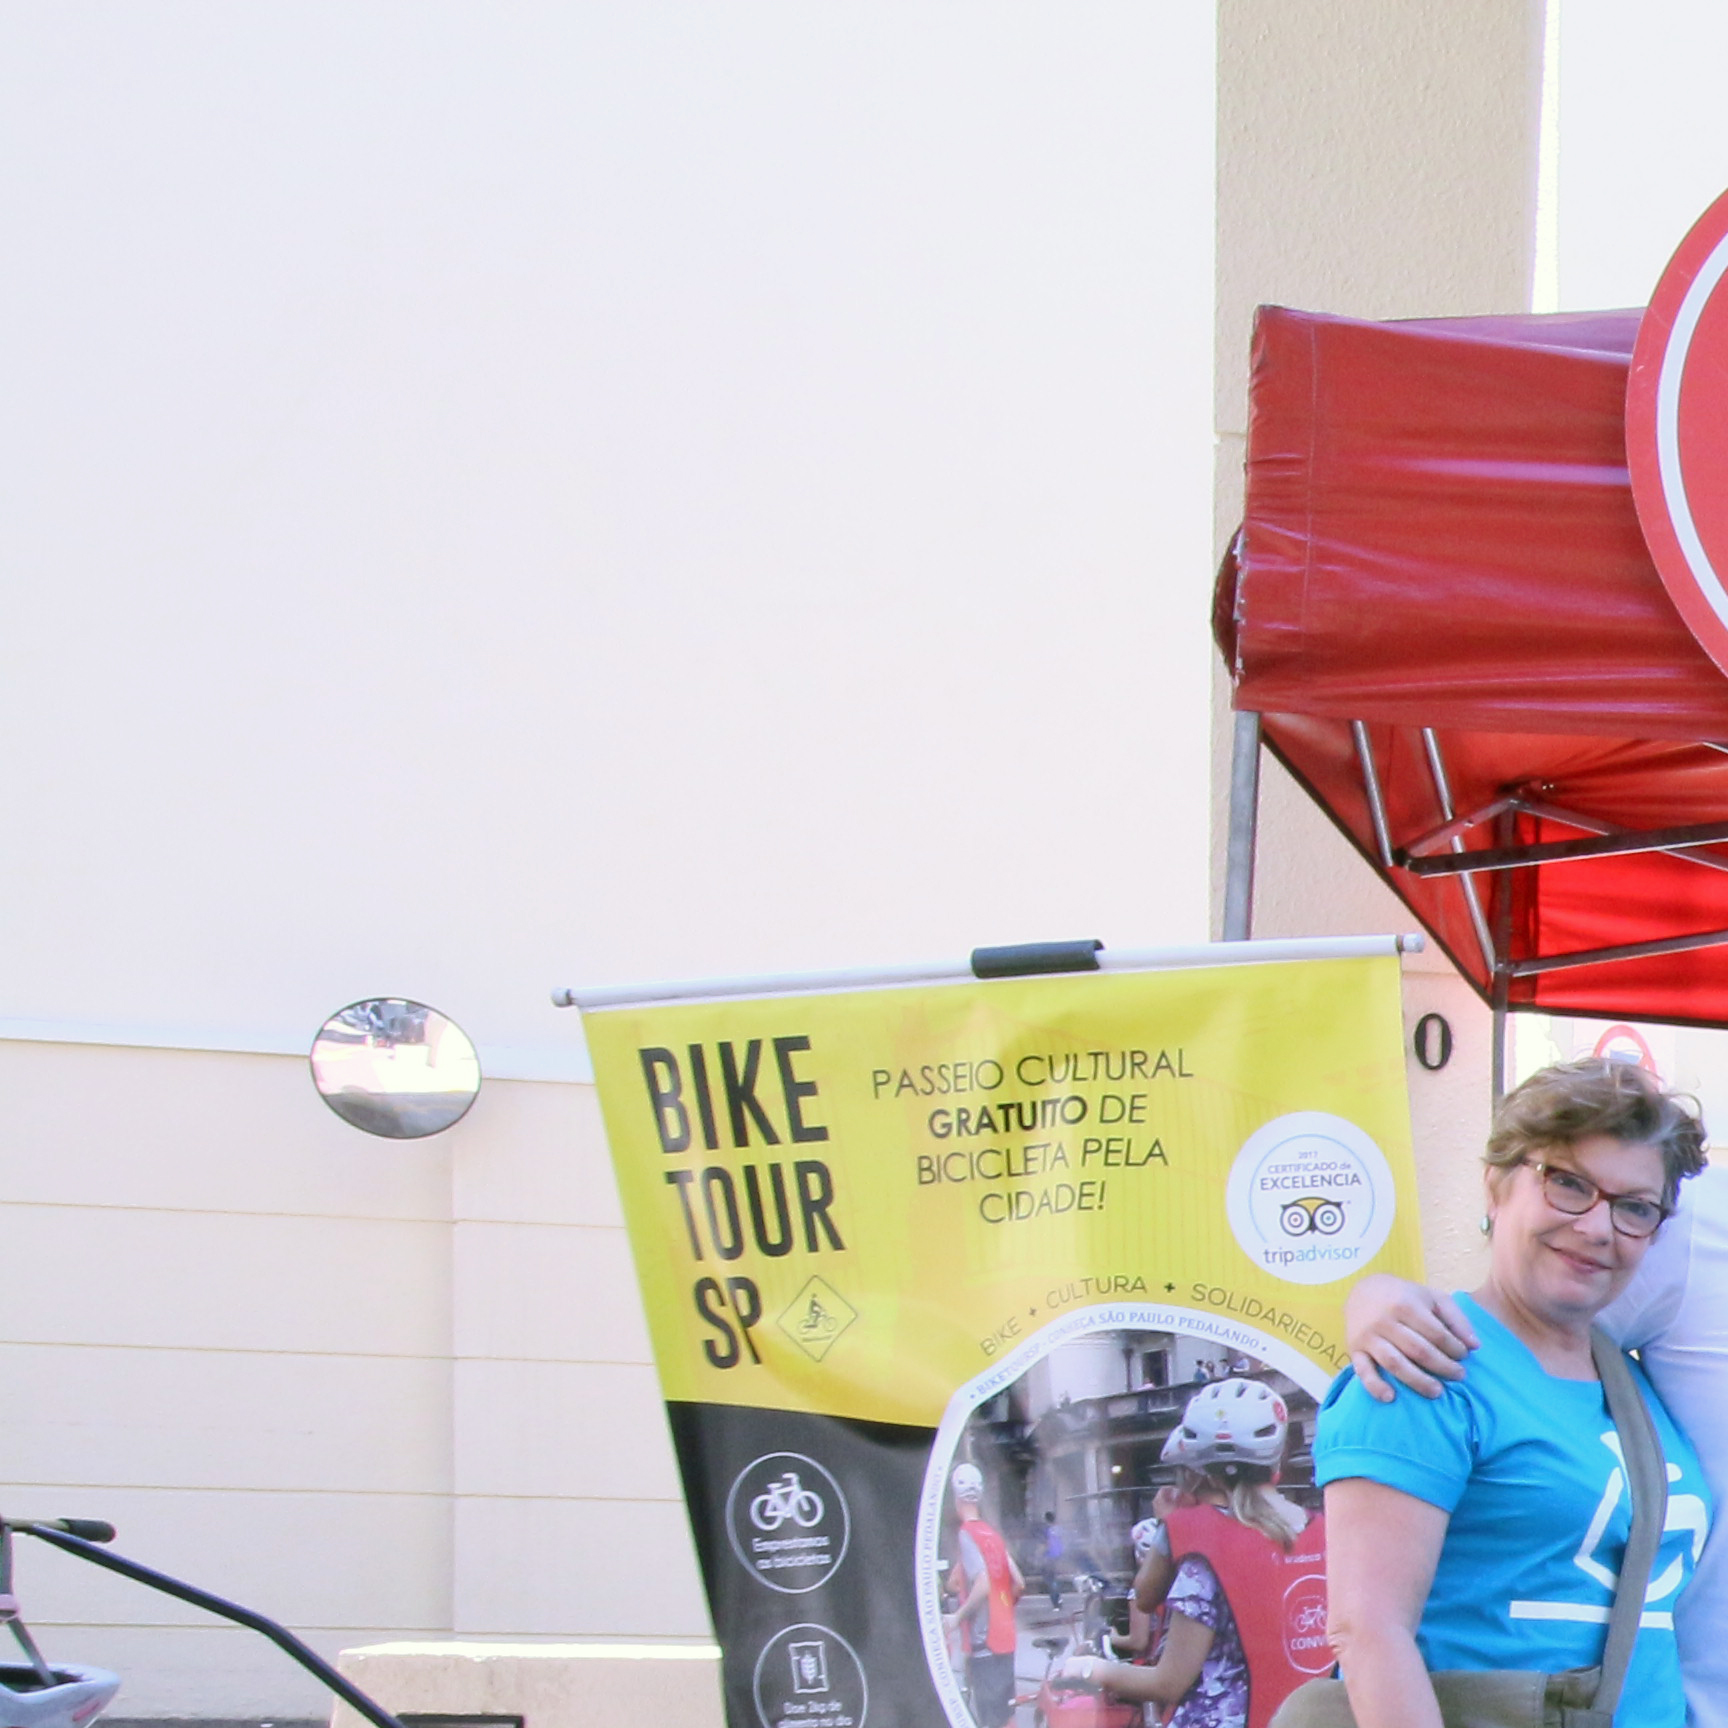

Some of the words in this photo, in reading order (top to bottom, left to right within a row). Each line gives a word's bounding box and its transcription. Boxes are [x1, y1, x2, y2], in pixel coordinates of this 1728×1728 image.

[638, 1034, 831, 1154] BIKE
[872, 1059, 1004, 1099] PASSEIO
[1016, 1048, 1194, 1087] CULTURAL
[928, 1095, 1088, 1139] GRATUITO
[1098, 1094, 1148, 1124] DE
[916, 1142, 1070, 1185] BICICLETA
[1081, 1137, 1169, 1168] PELA
[1267, 1161, 1338, 1174] CERTIFICADO
[1339, 1162, 1352, 1171] de
[1298, 1151, 1318, 1159] 2017
[663, 1159, 848, 1263] TOUR
[979, 1180, 1107, 1225] CIDADE!
[1263, 1244, 1361, 1266] tripadvisor
[693, 1275, 764, 1370] SP
[979, 1316, 1022, 1356] BIKE
[1045, 1275, 1148, 1310] CULTURA
[1098, 1309, 1125, 1324] SÃO
[1129, 1311, 1175, 1325] PAULO
[1178, 1316, 1260, 1350] PEDALANDO
